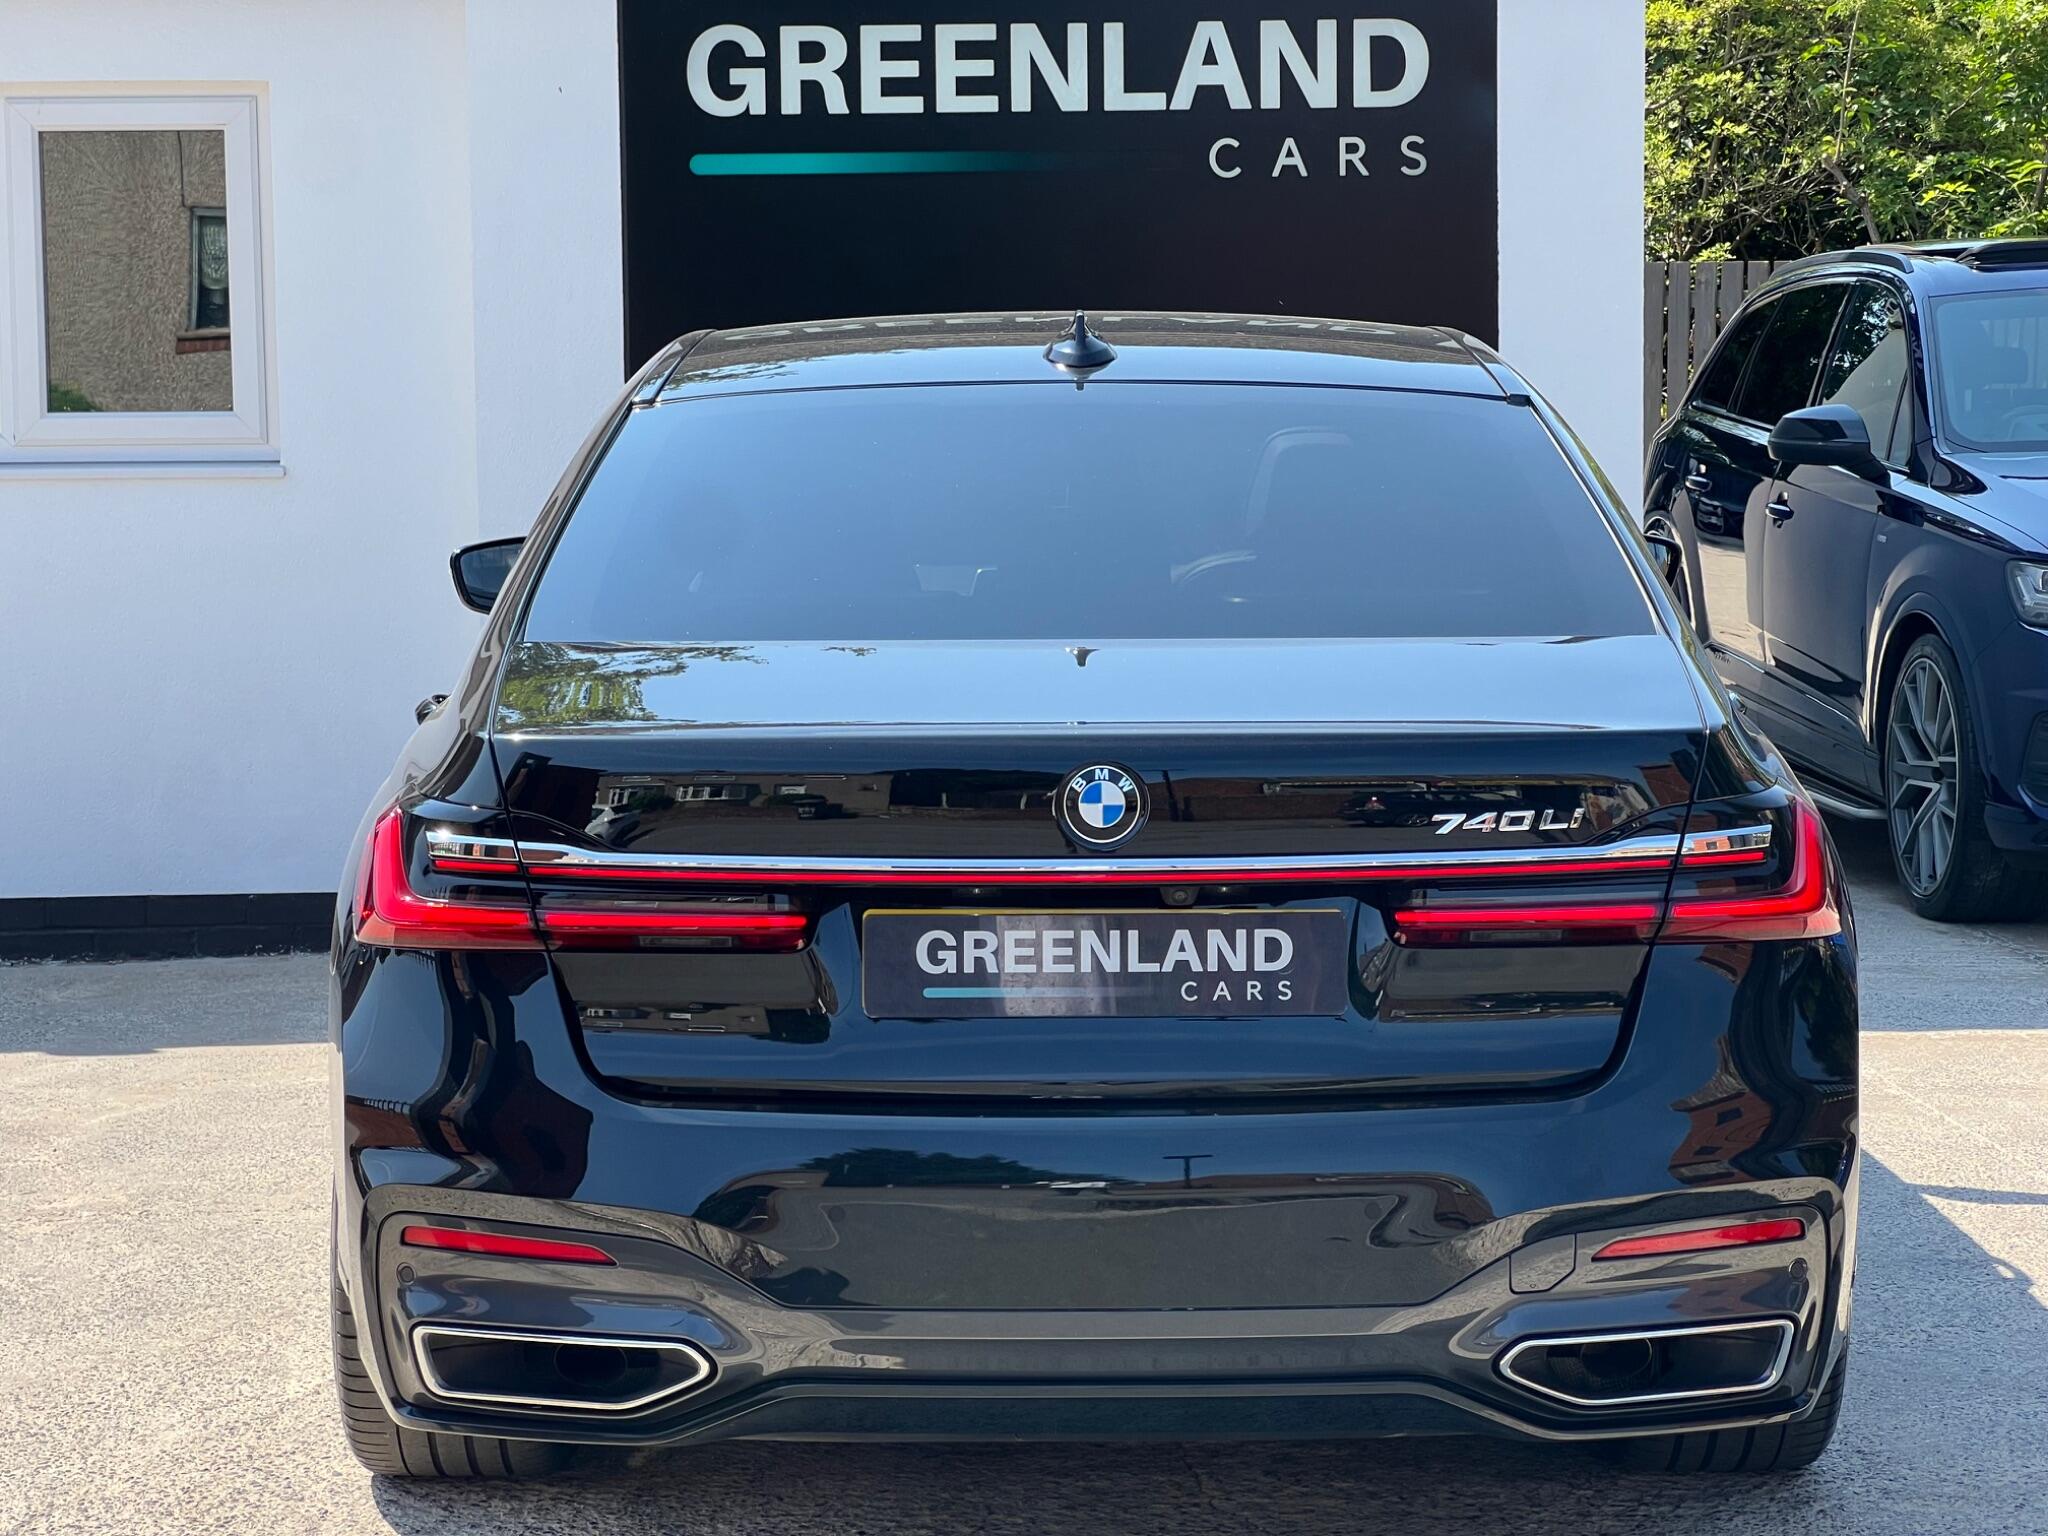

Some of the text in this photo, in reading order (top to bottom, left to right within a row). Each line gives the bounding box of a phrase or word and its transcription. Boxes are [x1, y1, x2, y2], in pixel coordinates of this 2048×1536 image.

[686, 18, 1430, 117] GREENLAND
[1208, 135, 1428, 178] CARS
[1071, 768, 1134, 793] BMW
[915, 928, 1294, 974] GREENLAND
[1180, 980, 1293, 1002] CARS
